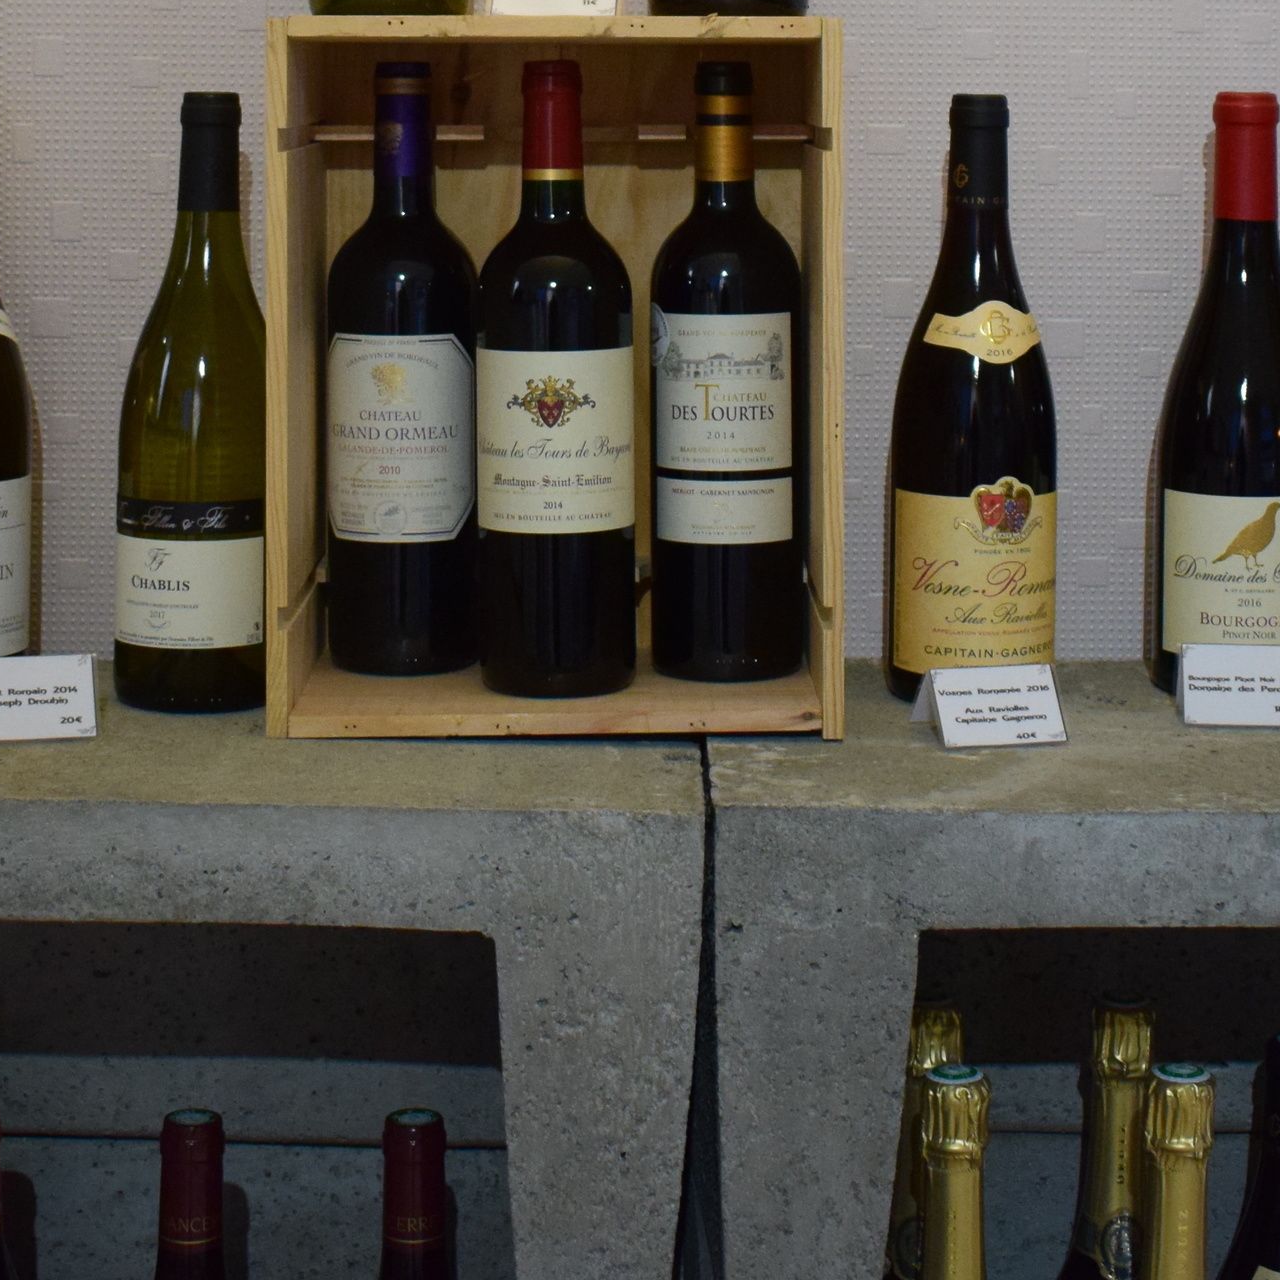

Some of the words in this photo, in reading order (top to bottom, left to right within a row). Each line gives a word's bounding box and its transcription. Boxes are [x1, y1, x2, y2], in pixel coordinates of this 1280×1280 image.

[987, 348, 1013, 357] 2016
[671, 405, 697, 420] DES
[333, 424, 380, 440] GRAND
[385, 425, 458, 440] ORMEAU
[575, 440, 589, 458] de
[379, 466, 400, 475] 2010
[543, 501, 563, 509] 2014
[1174, 554, 1244, 583] Domaine
[1246, 570, 1267, 583] des
[131, 575, 190, 592] CHABLIS
[1238, 598, 1262, 607] 2016
[1222, 630, 1250, 639] PINOT
[1253, 630, 1277, 639] NOIR
[8, 688, 47, 696] Romain
[53, 686, 78, 694] 2014
[1188, 684, 1232, 693] Domaine
[28, 697, 68, 705] Drouhin
